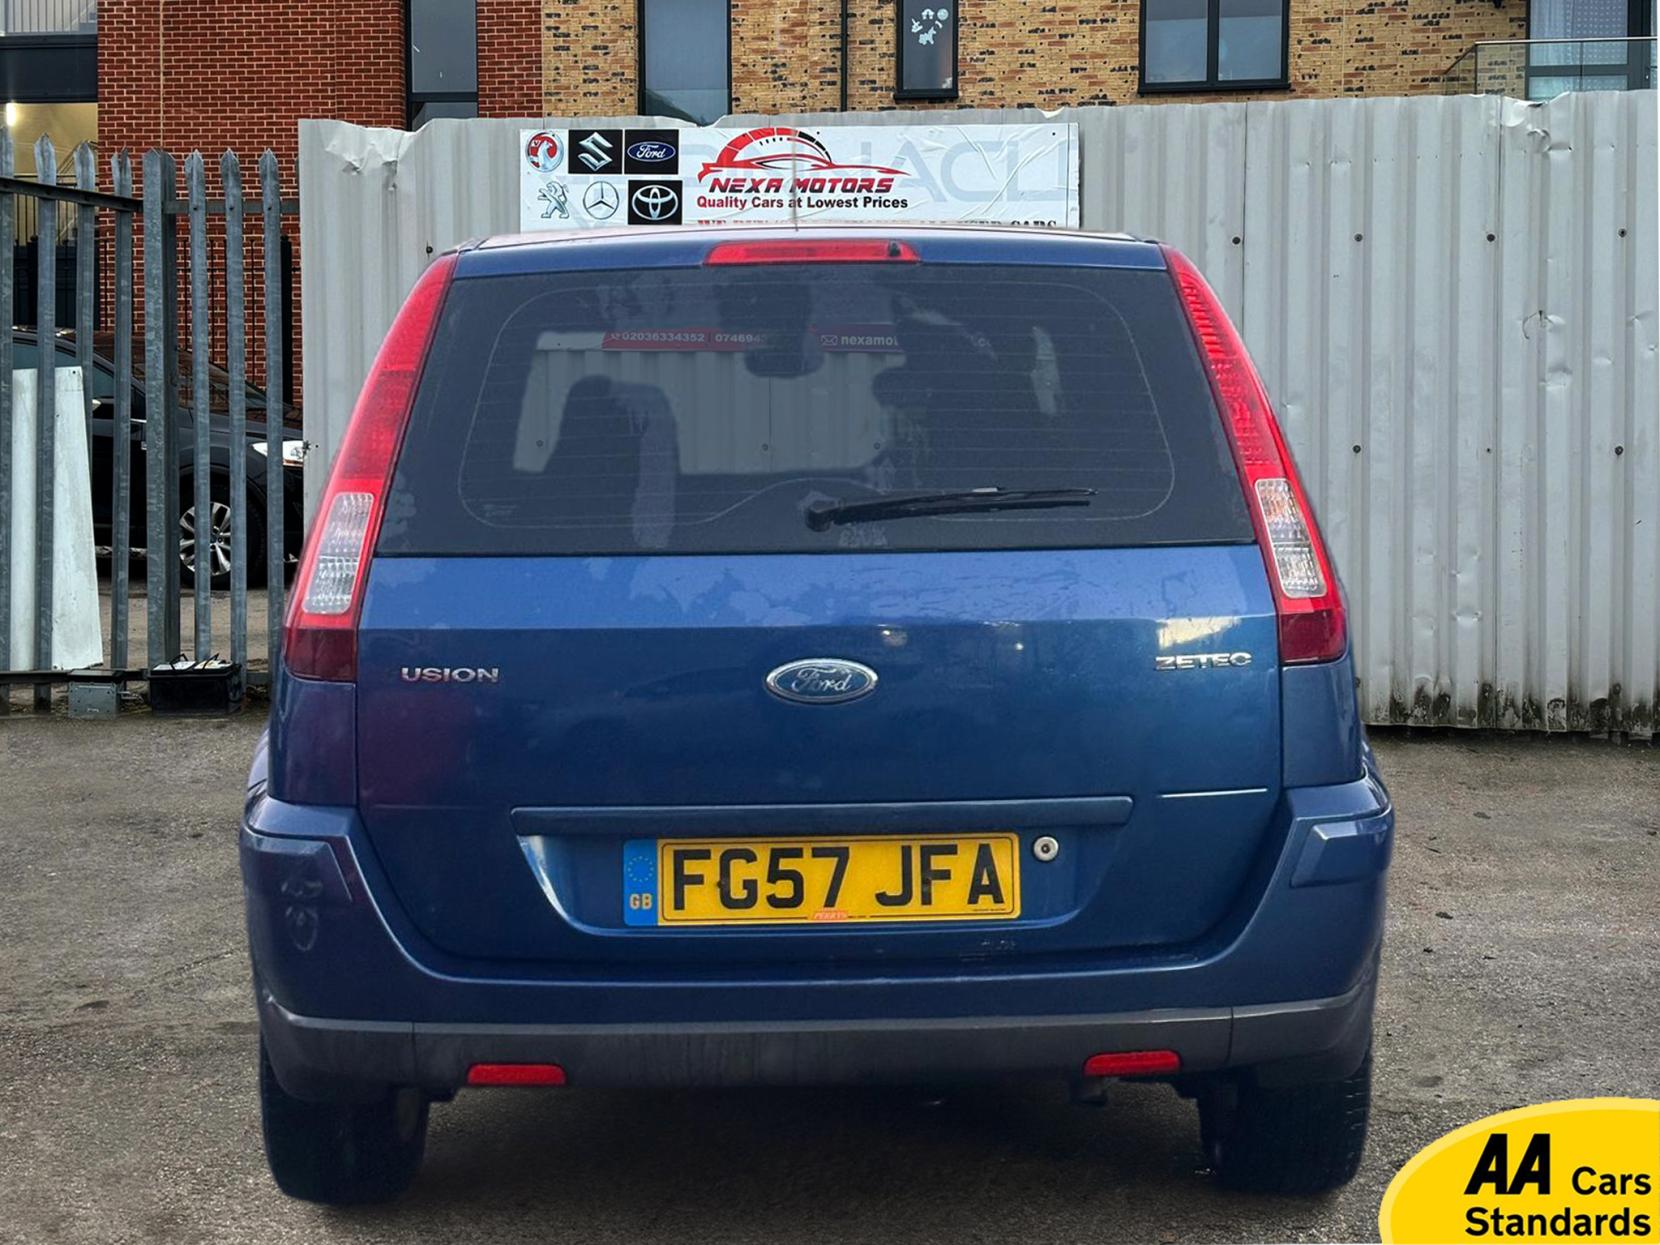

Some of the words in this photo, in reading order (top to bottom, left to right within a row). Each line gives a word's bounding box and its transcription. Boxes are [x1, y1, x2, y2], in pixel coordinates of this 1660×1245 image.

[636, 144, 666, 158] Ford
[709, 178, 783, 193] NEXA
[789, 178, 895, 193] MOTORS
[697, 196, 747, 210] Quality
[752, 197, 784, 208] Cars
[788, 198, 802, 208] at
[807, 196, 859, 208] Lowest
[863, 196, 908, 208] Prices
[1155, 652, 1252, 671] ZETEC
[401, 667, 499, 682] USION
[791, 667, 853, 692] Ford
[672, 846, 850, 911] FG57
[875, 843, 1005, 907] JFA
[630, 893, 653, 910] GB
